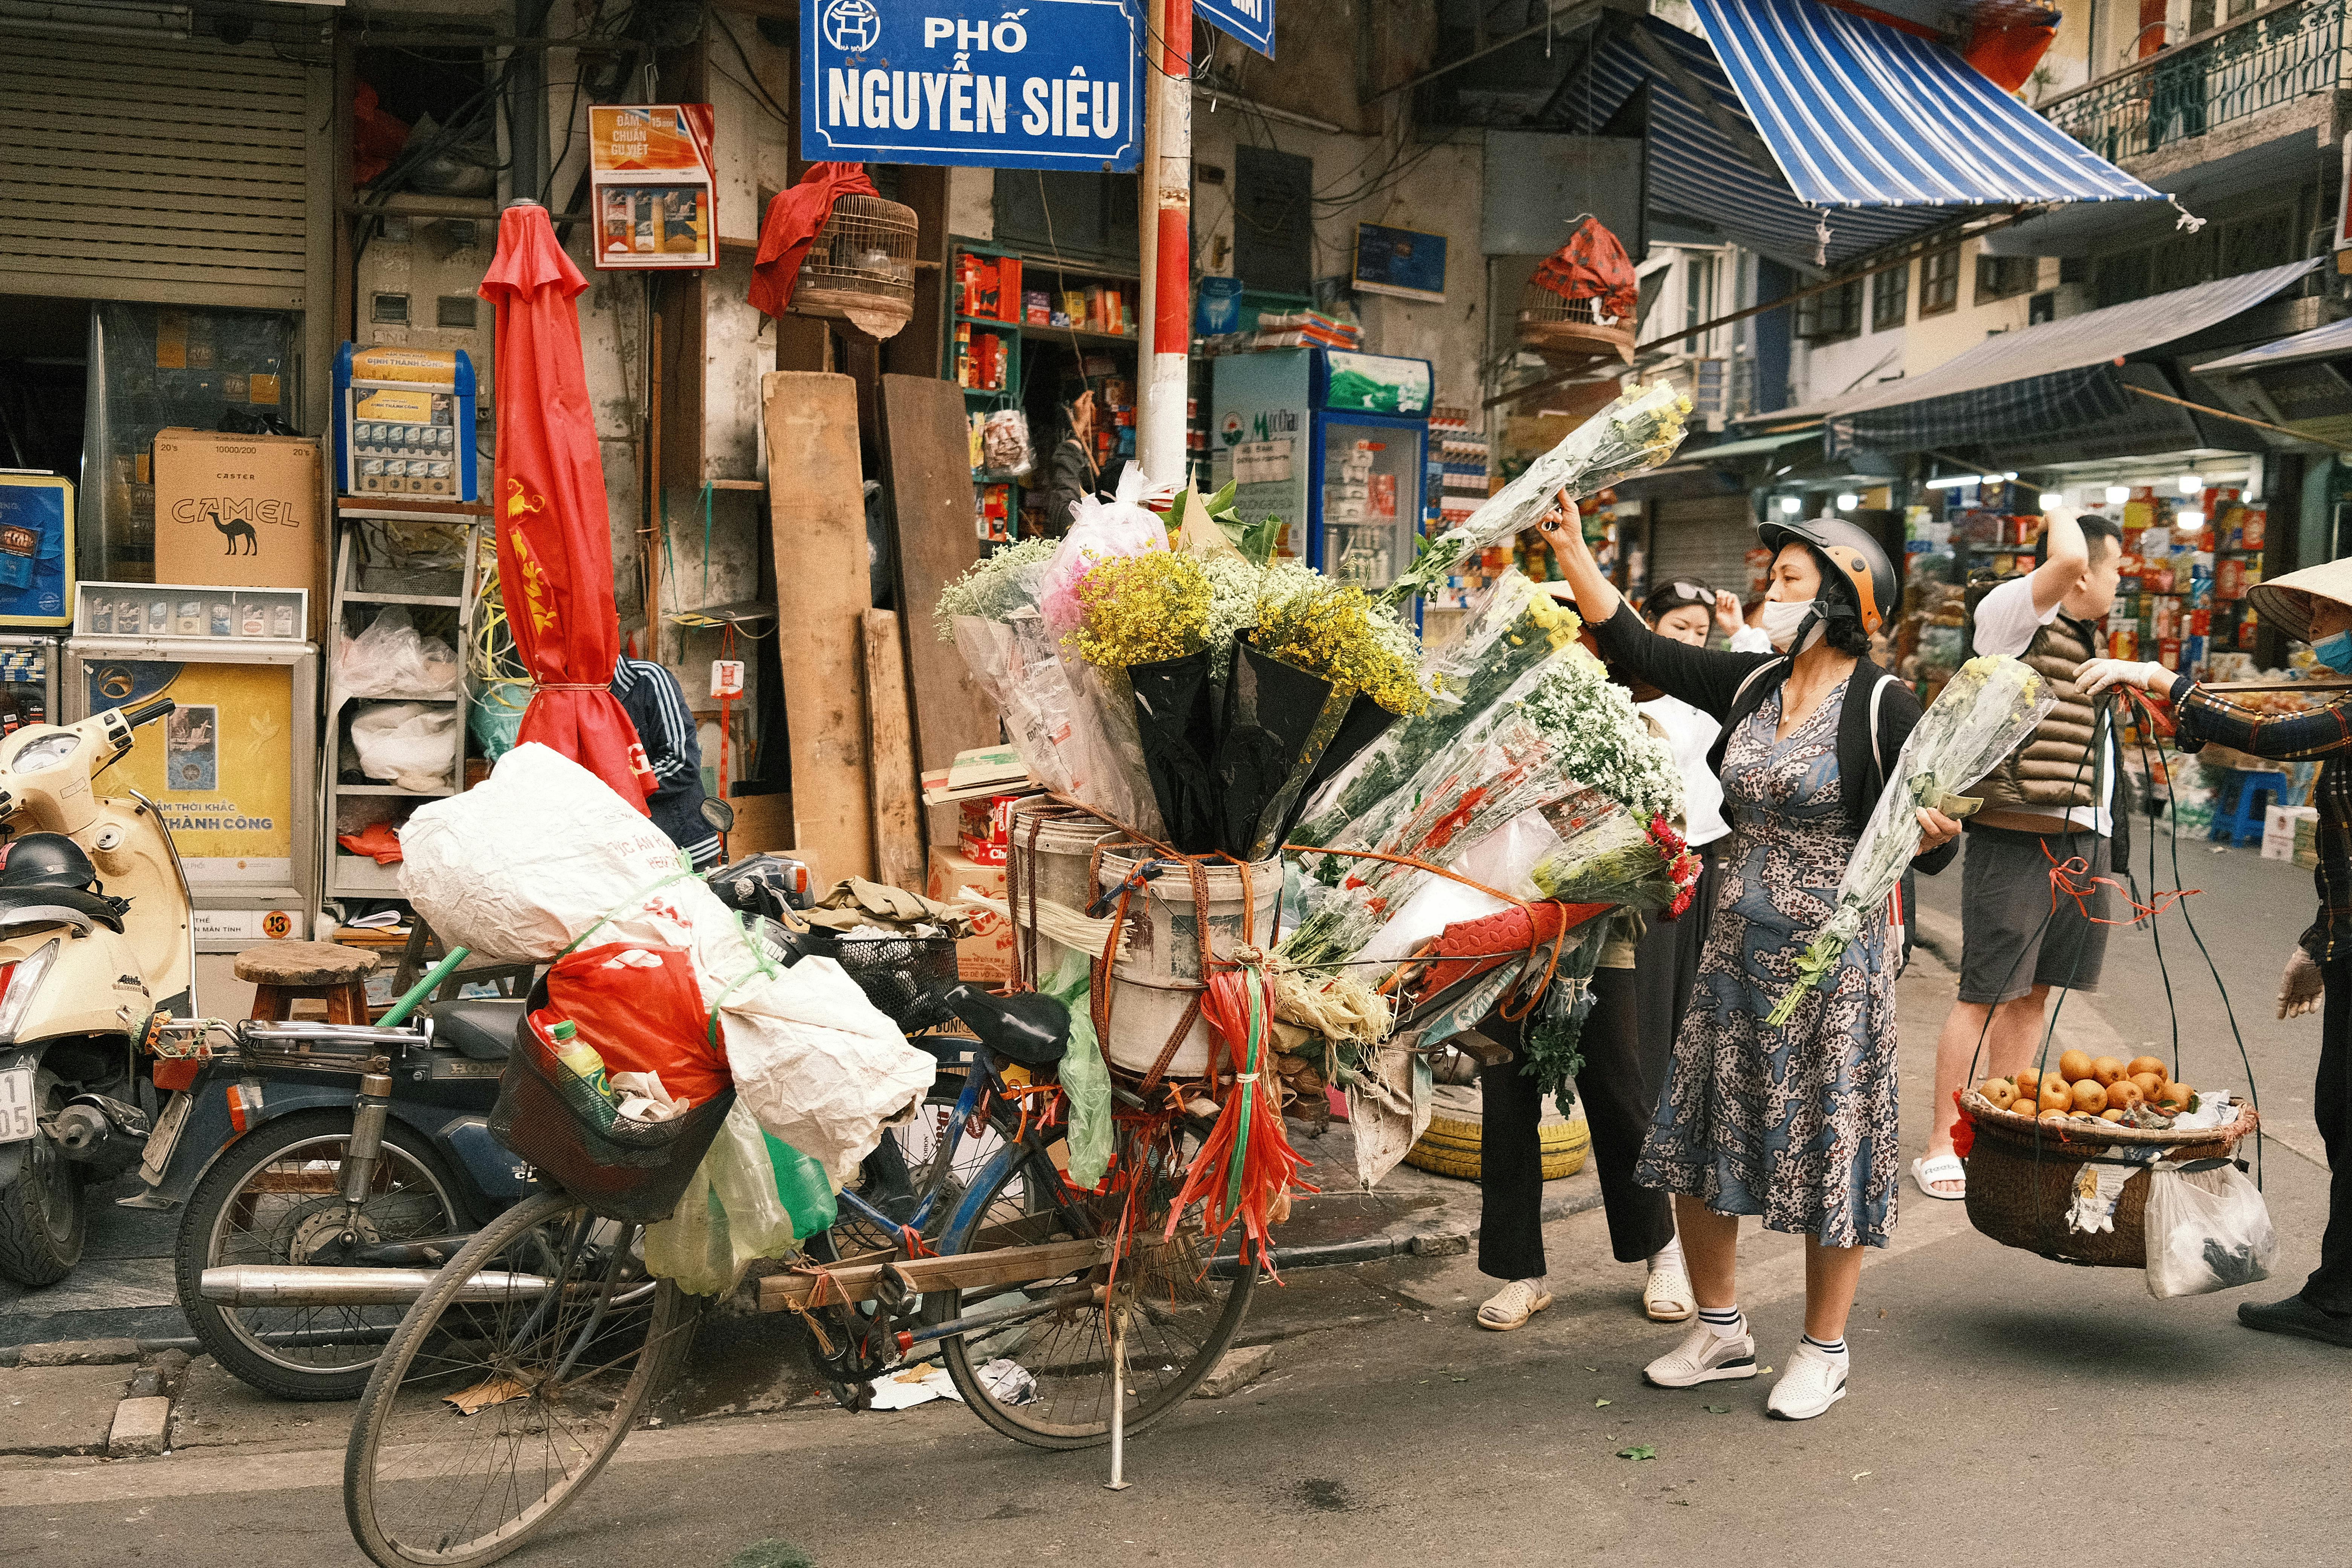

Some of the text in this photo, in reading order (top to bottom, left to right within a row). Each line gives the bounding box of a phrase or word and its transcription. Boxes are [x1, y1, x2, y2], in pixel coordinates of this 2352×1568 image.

[925, 8, 1027, 53] PHỐ
[829, 52, 1119, 139] NGUYỄN SIÊU
[613, 127, 646, 141] CHUẨN
[611, 143, 649, 158] GU VIỆT
[390, 358, 419, 366] THÀNH
[171, 497, 300, 528] CAMEL
[175, 801, 202, 812] THỜI
[205, 799, 235, 812] KHẮC
[223, 815, 273, 830] CÔNG
[269, 916, 285, 933] 18
